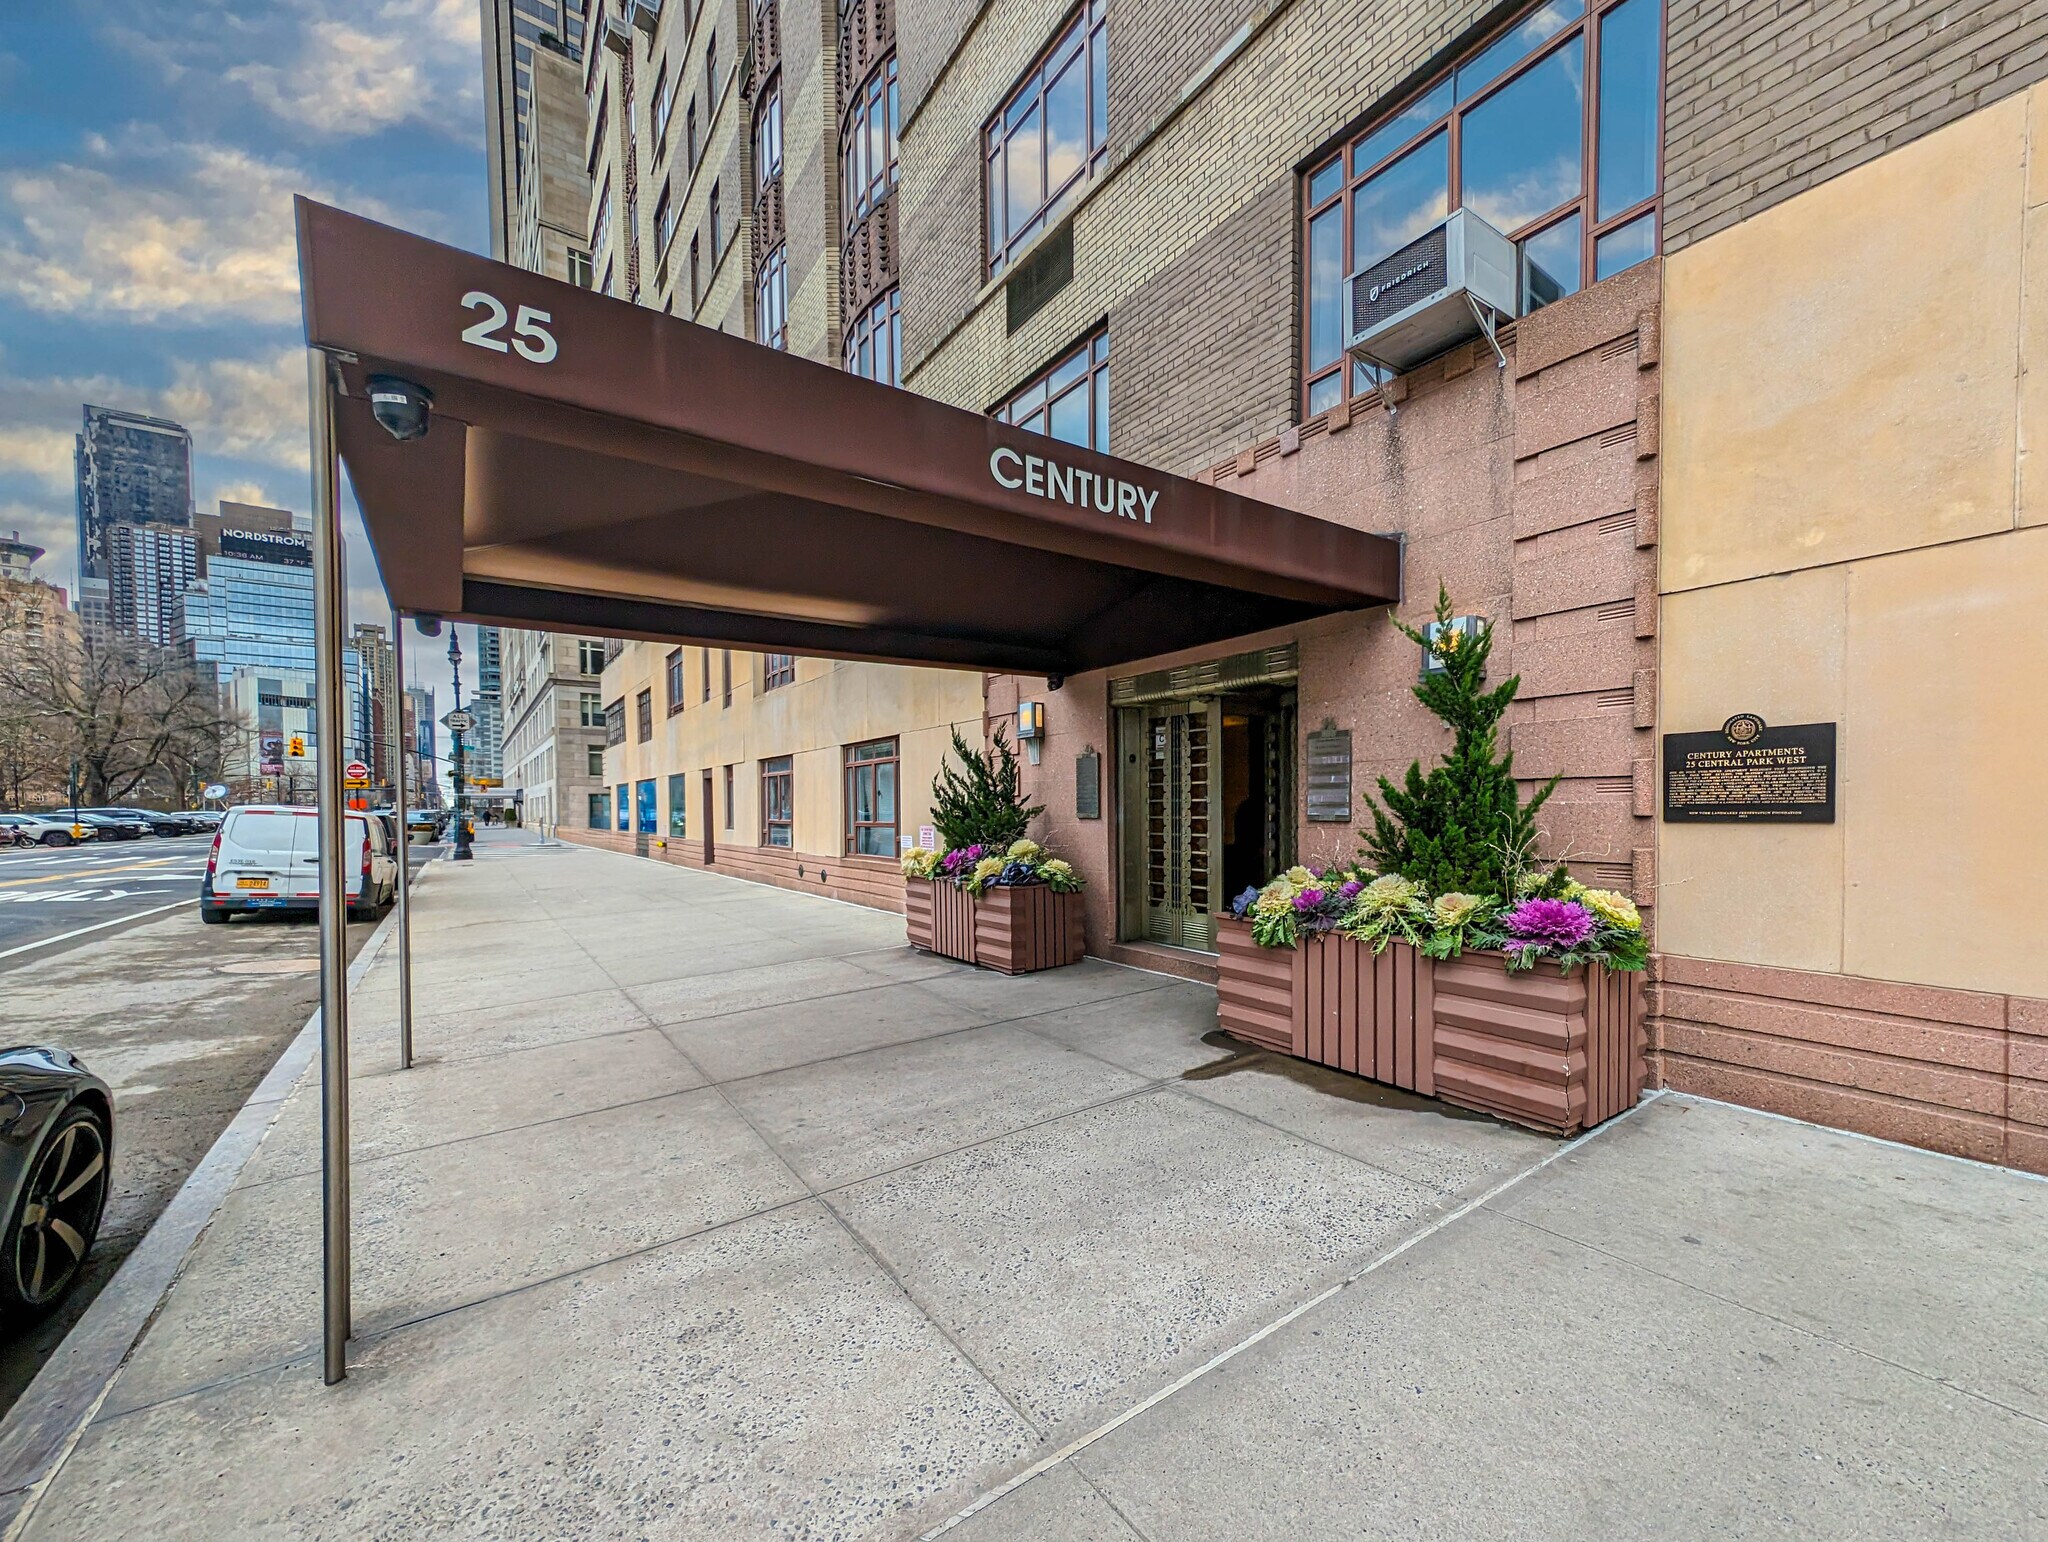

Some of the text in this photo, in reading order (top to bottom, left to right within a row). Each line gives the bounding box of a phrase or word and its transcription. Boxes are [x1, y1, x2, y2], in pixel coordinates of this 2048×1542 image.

[1381, 260, 1430, 292] FRIEDRICH
[460, 291, 558, 364] 25
[989, 447, 1160, 524] CENTURY
[222, 528, 305, 547] NORDSTROM
[1685, 756, 1807, 769] 25 CENTRAL PARK WEST
[1687, 747, 1805, 760] CENTURY APARTMENTS
